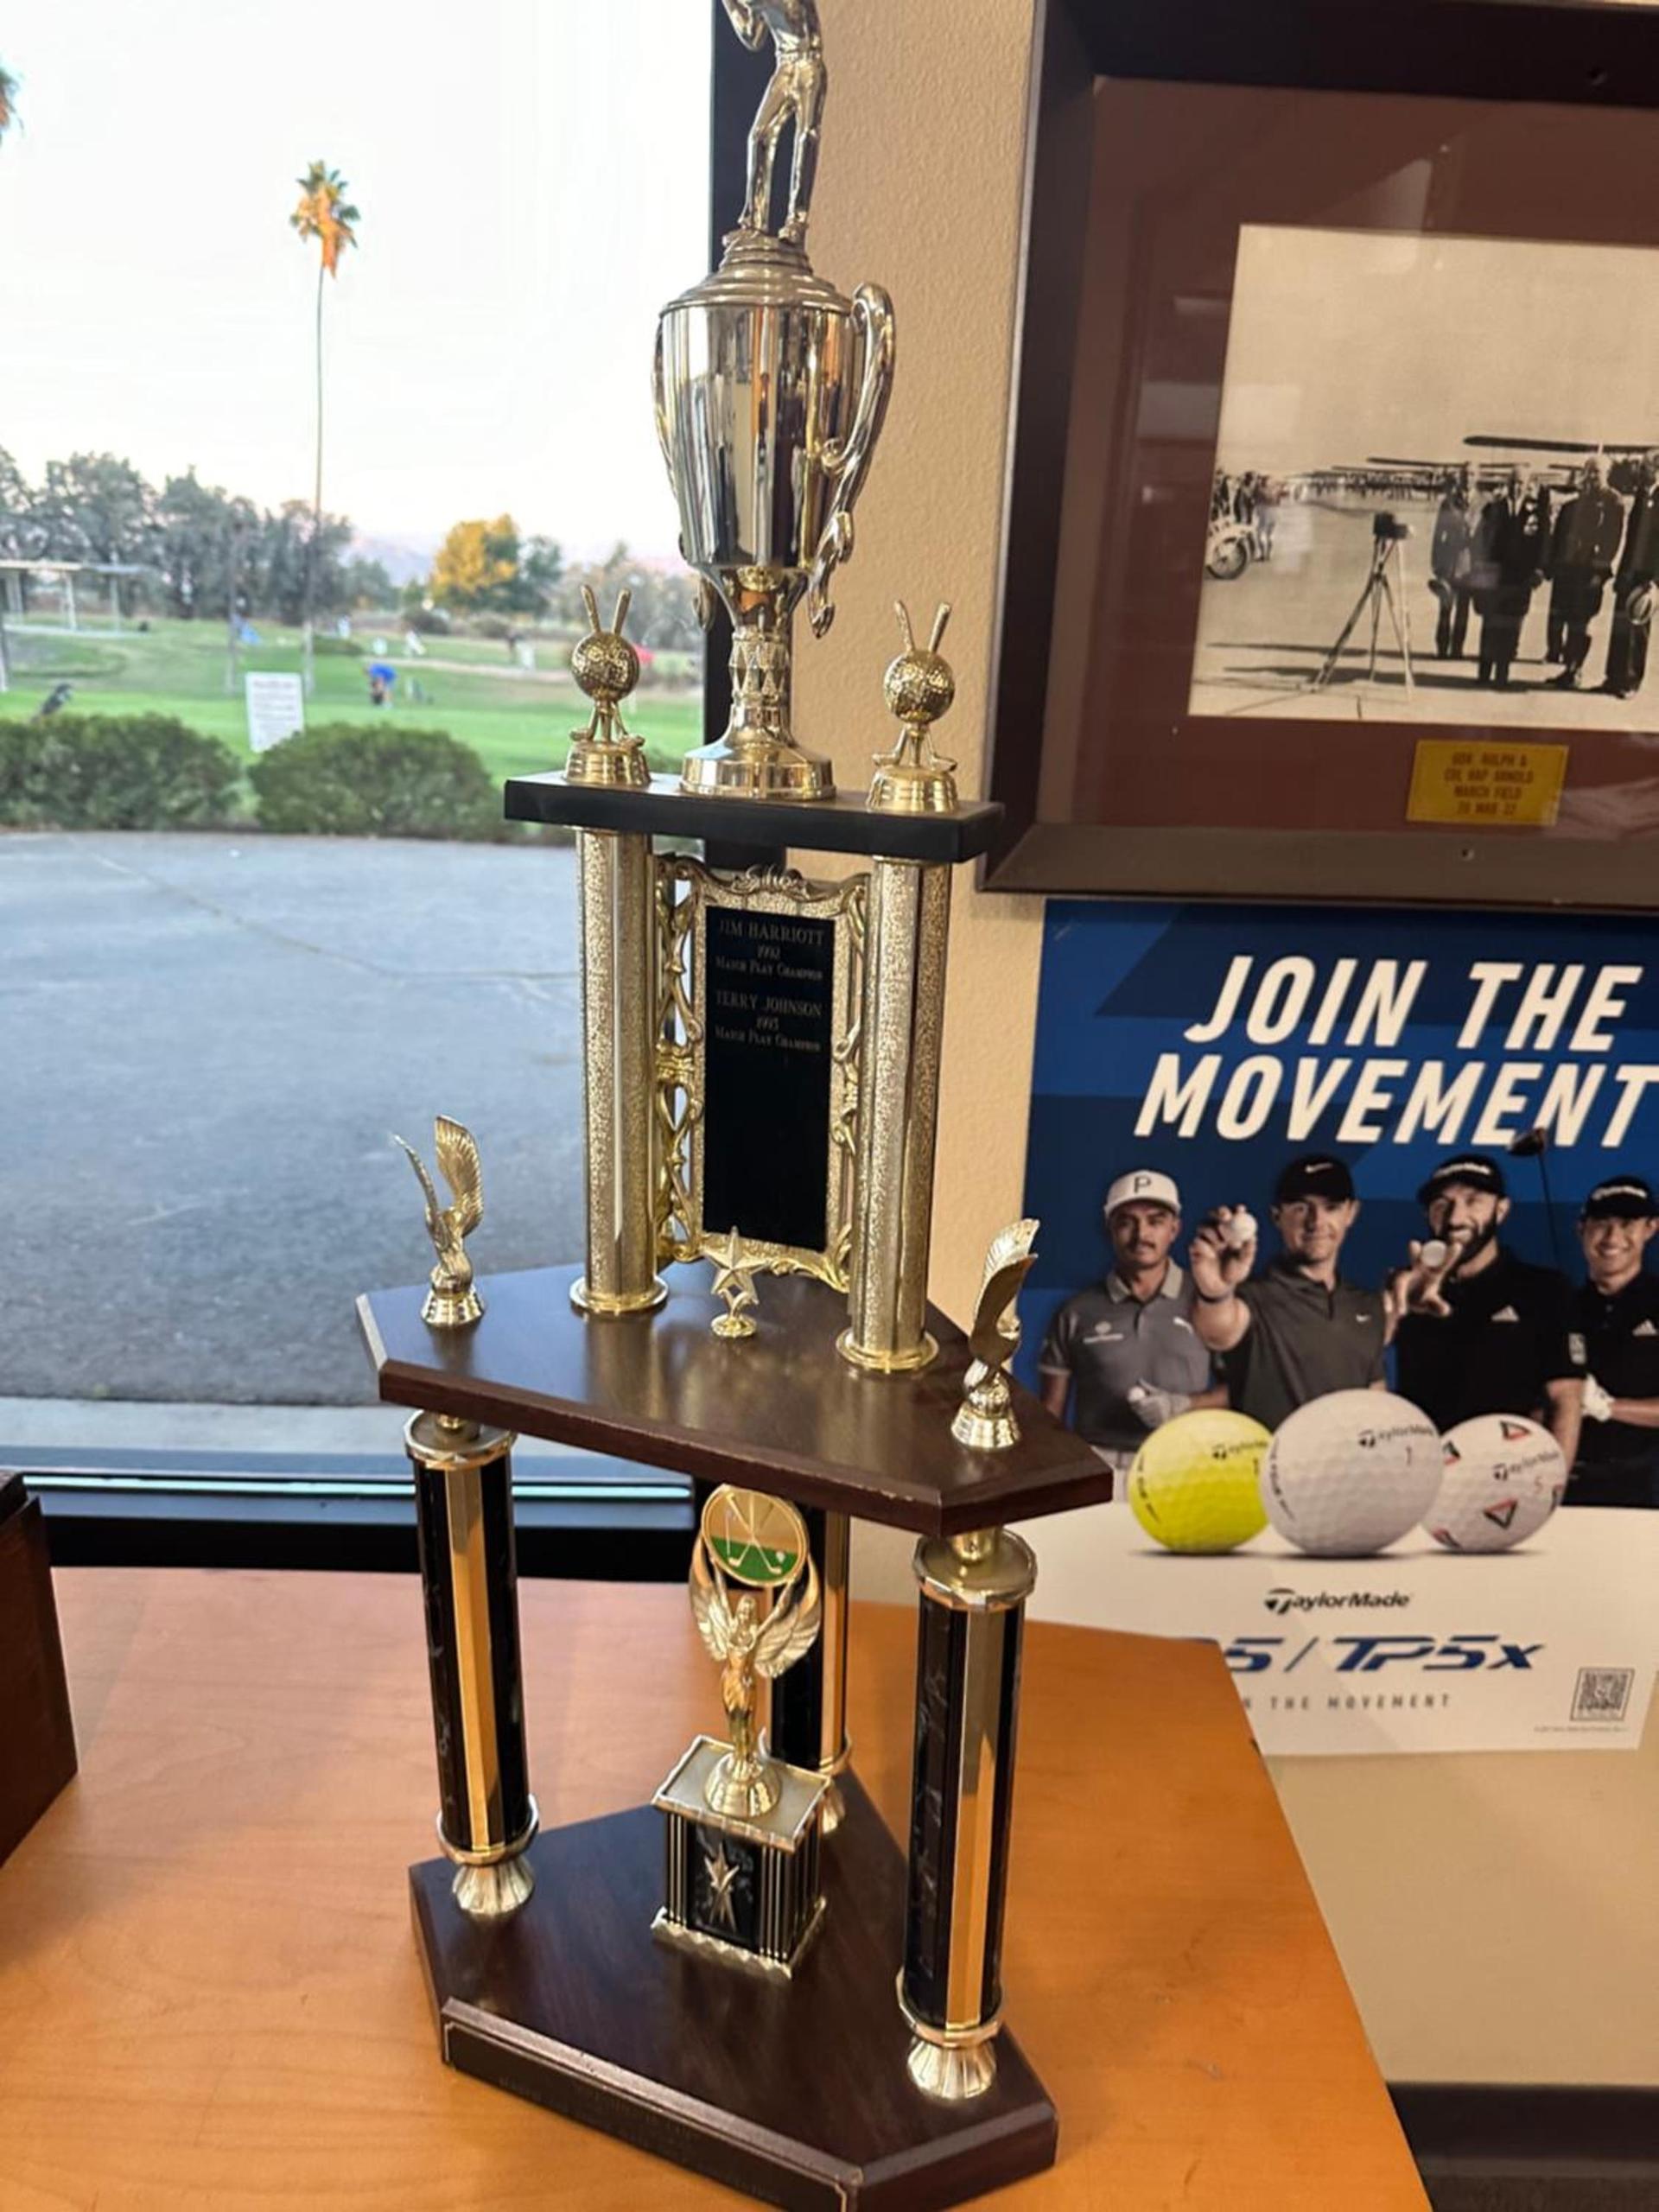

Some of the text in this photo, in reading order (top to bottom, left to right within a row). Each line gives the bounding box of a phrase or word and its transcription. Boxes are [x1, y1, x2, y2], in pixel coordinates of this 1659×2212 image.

[1453, 785, 1522, 800] MARCH FIELD
[748, 922, 824, 945] HARRIOTT
[716, 990, 822, 1018] TERRY JOHNSON
[1184, 956, 1643, 1052] JOIN THE
[1134, 1052, 1659, 1147] MOVEMENT
[1134, 1175, 1152, 1194] P
[1264, 1587, 1410, 1616] TaylorMade
[1332, 1635, 1544, 1672] TP5x
[1270, 1694, 1452, 1710] THE MOVEMENT
